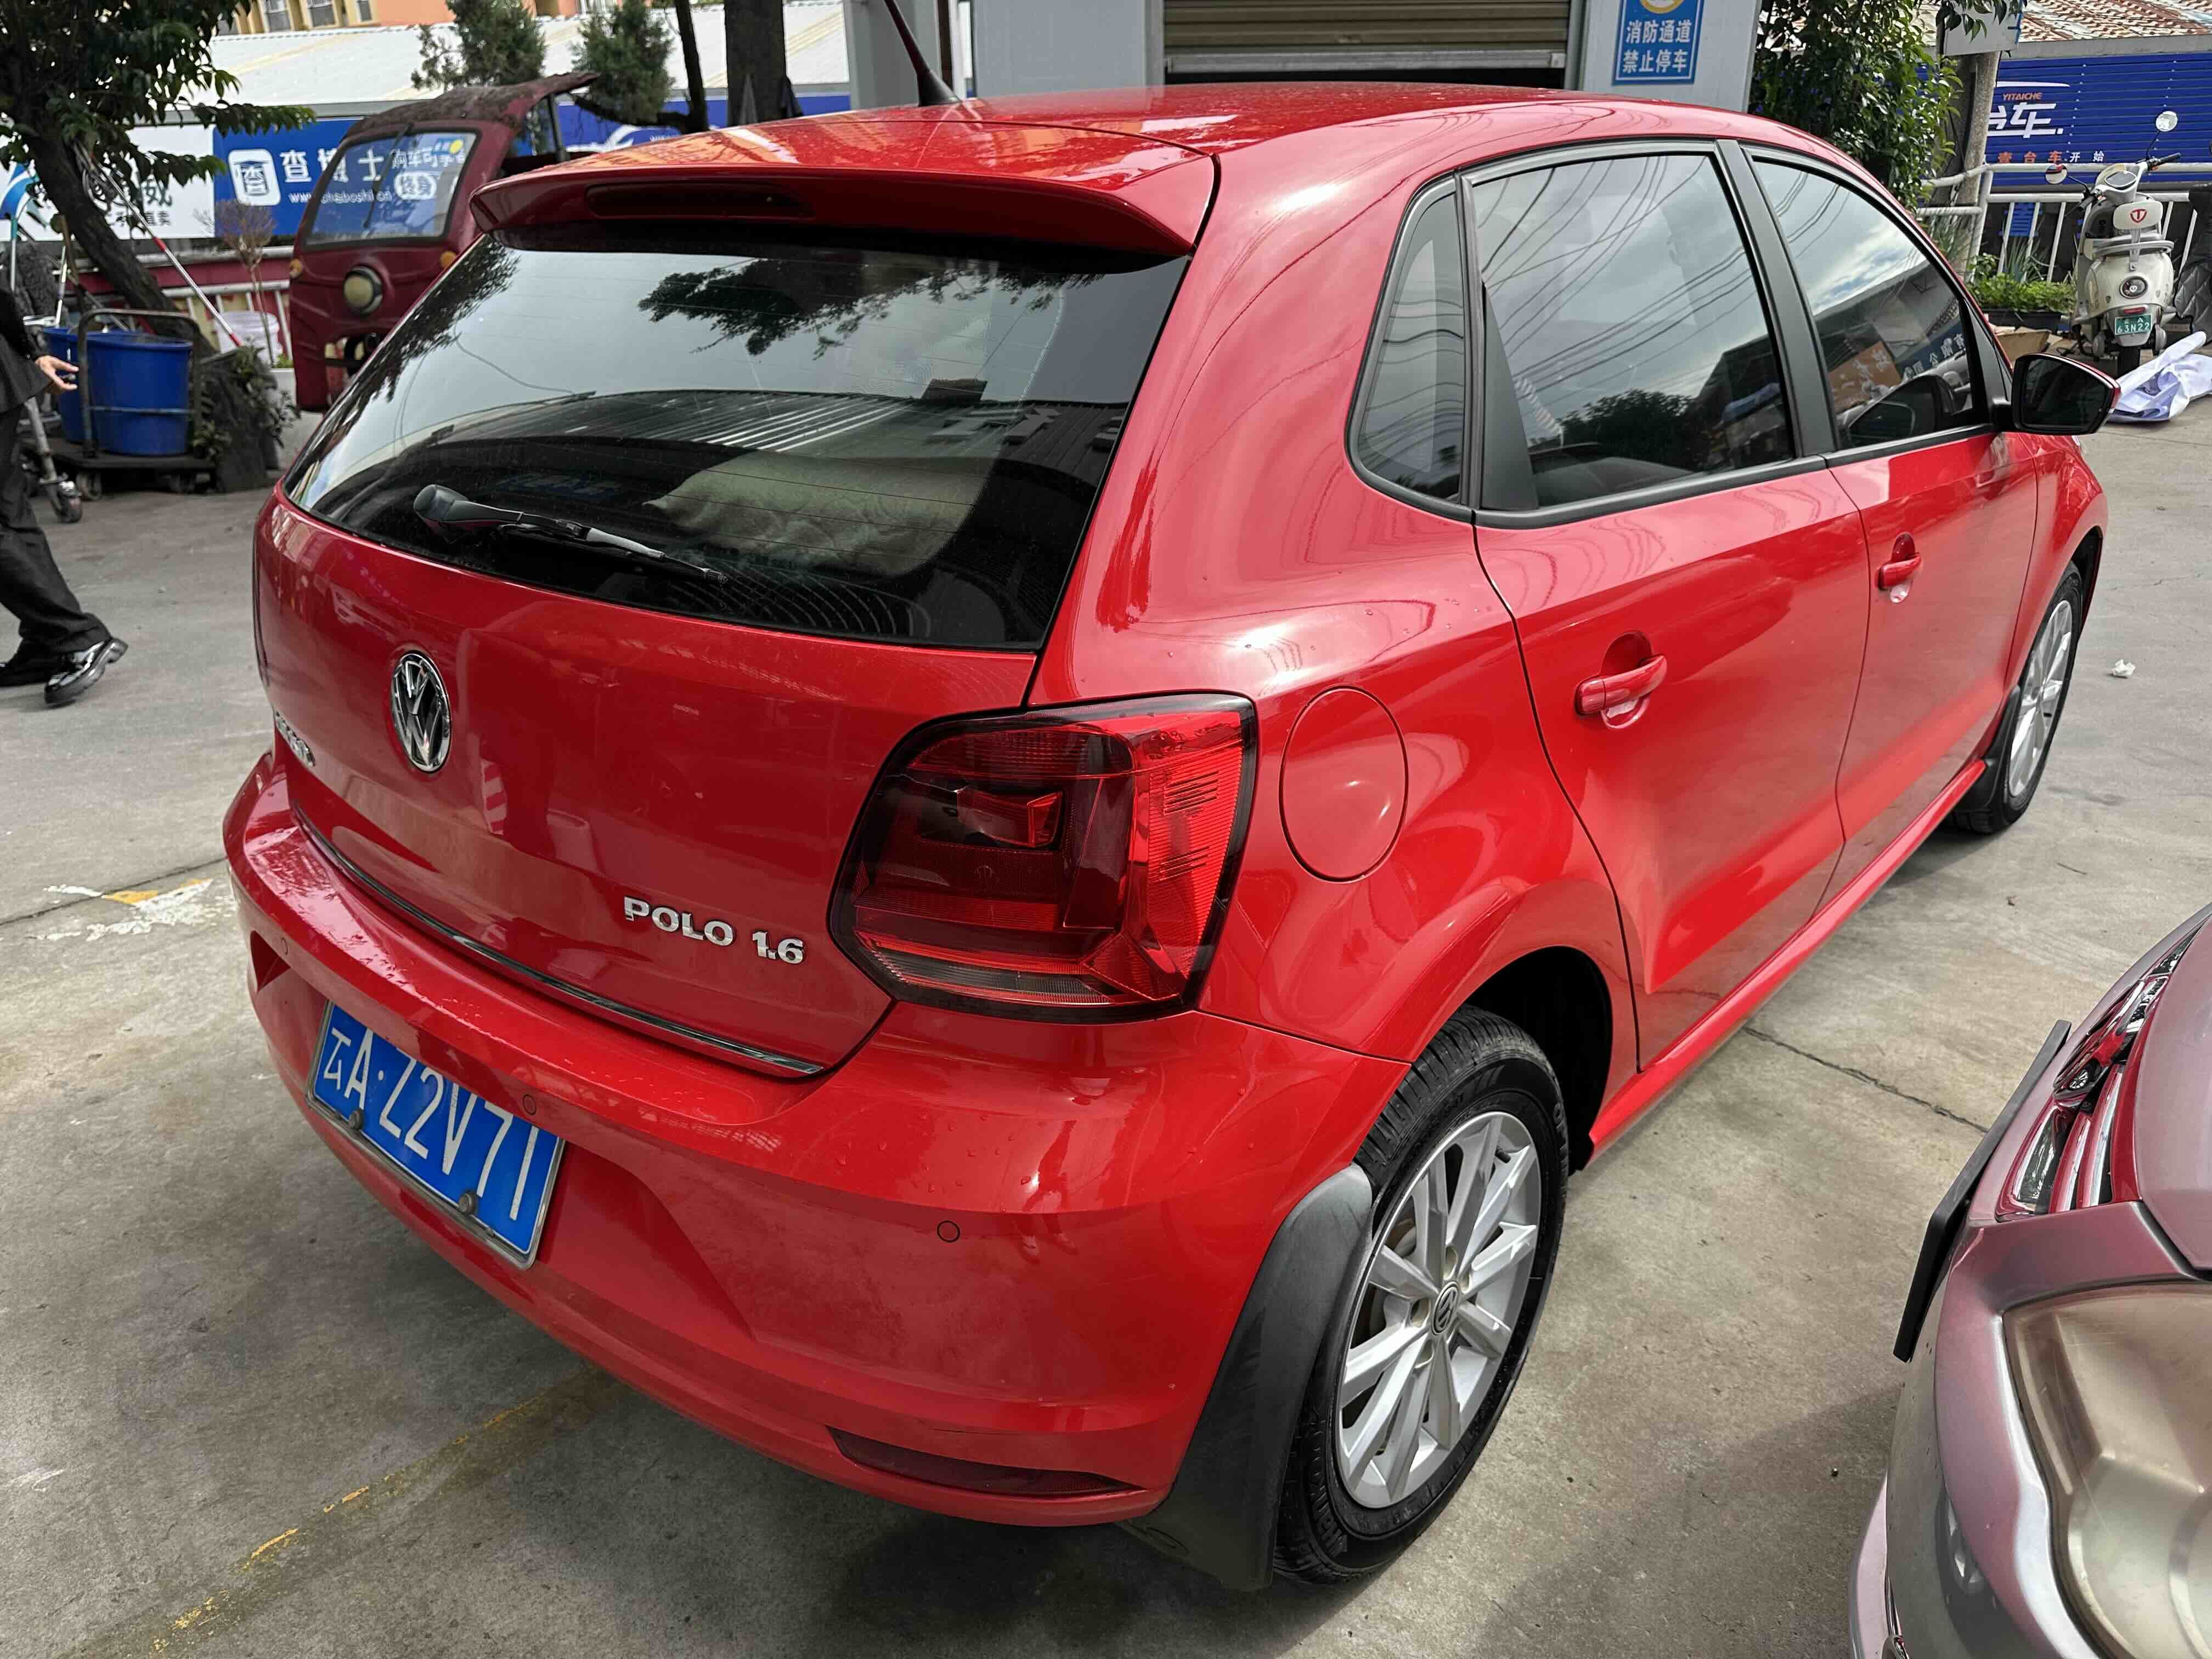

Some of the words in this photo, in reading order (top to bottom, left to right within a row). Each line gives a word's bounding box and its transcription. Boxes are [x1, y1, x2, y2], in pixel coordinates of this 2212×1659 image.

[1626, 19, 1692, 44] 消防通道
[1622, 49, 1688, 74] 禁止停车
[2003, 92, 2043, 101] YITAICHE
[624, 896, 733, 946] POLO
[752, 931, 804, 964] 1.6
